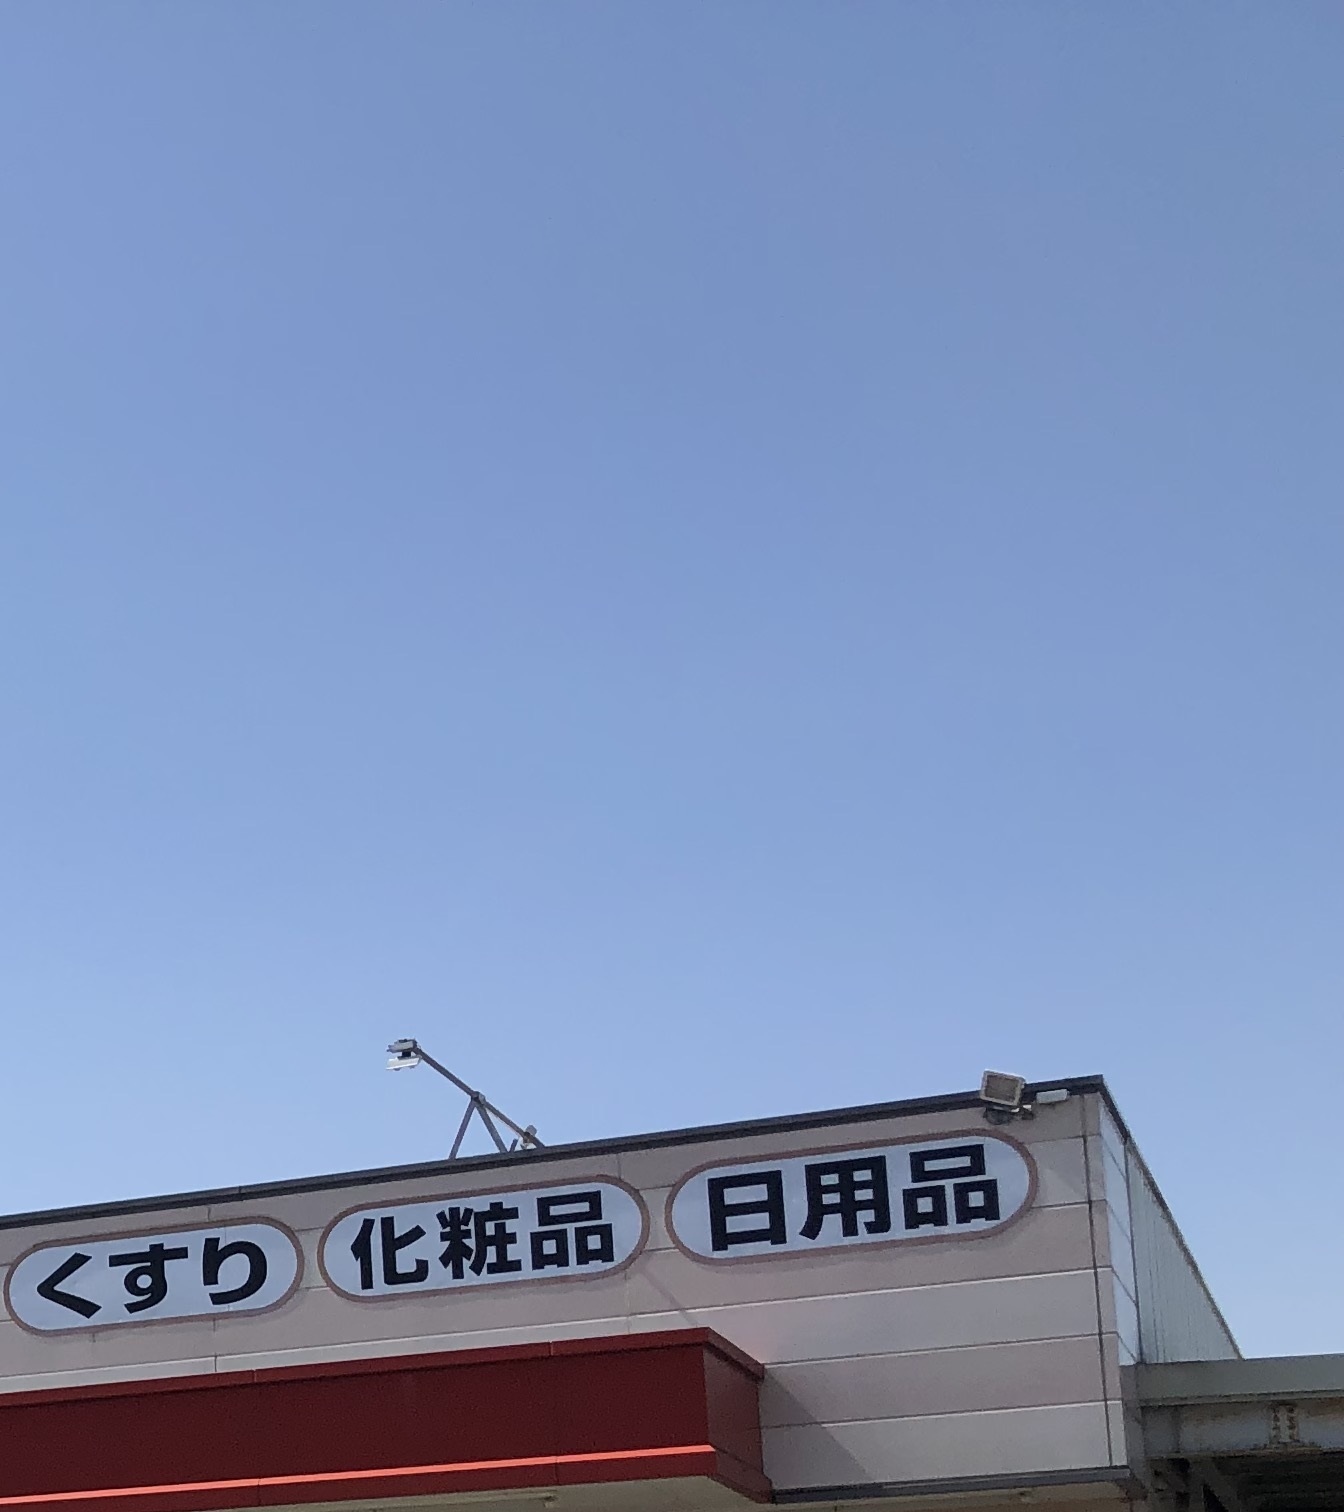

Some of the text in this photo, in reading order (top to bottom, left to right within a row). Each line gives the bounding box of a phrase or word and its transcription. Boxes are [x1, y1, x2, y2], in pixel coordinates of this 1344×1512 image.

[350, 1191, 617, 1291] 化粧品
[709, 1143, 1000, 1253] 日用品
[35, 1237, 269, 1319] くすり
